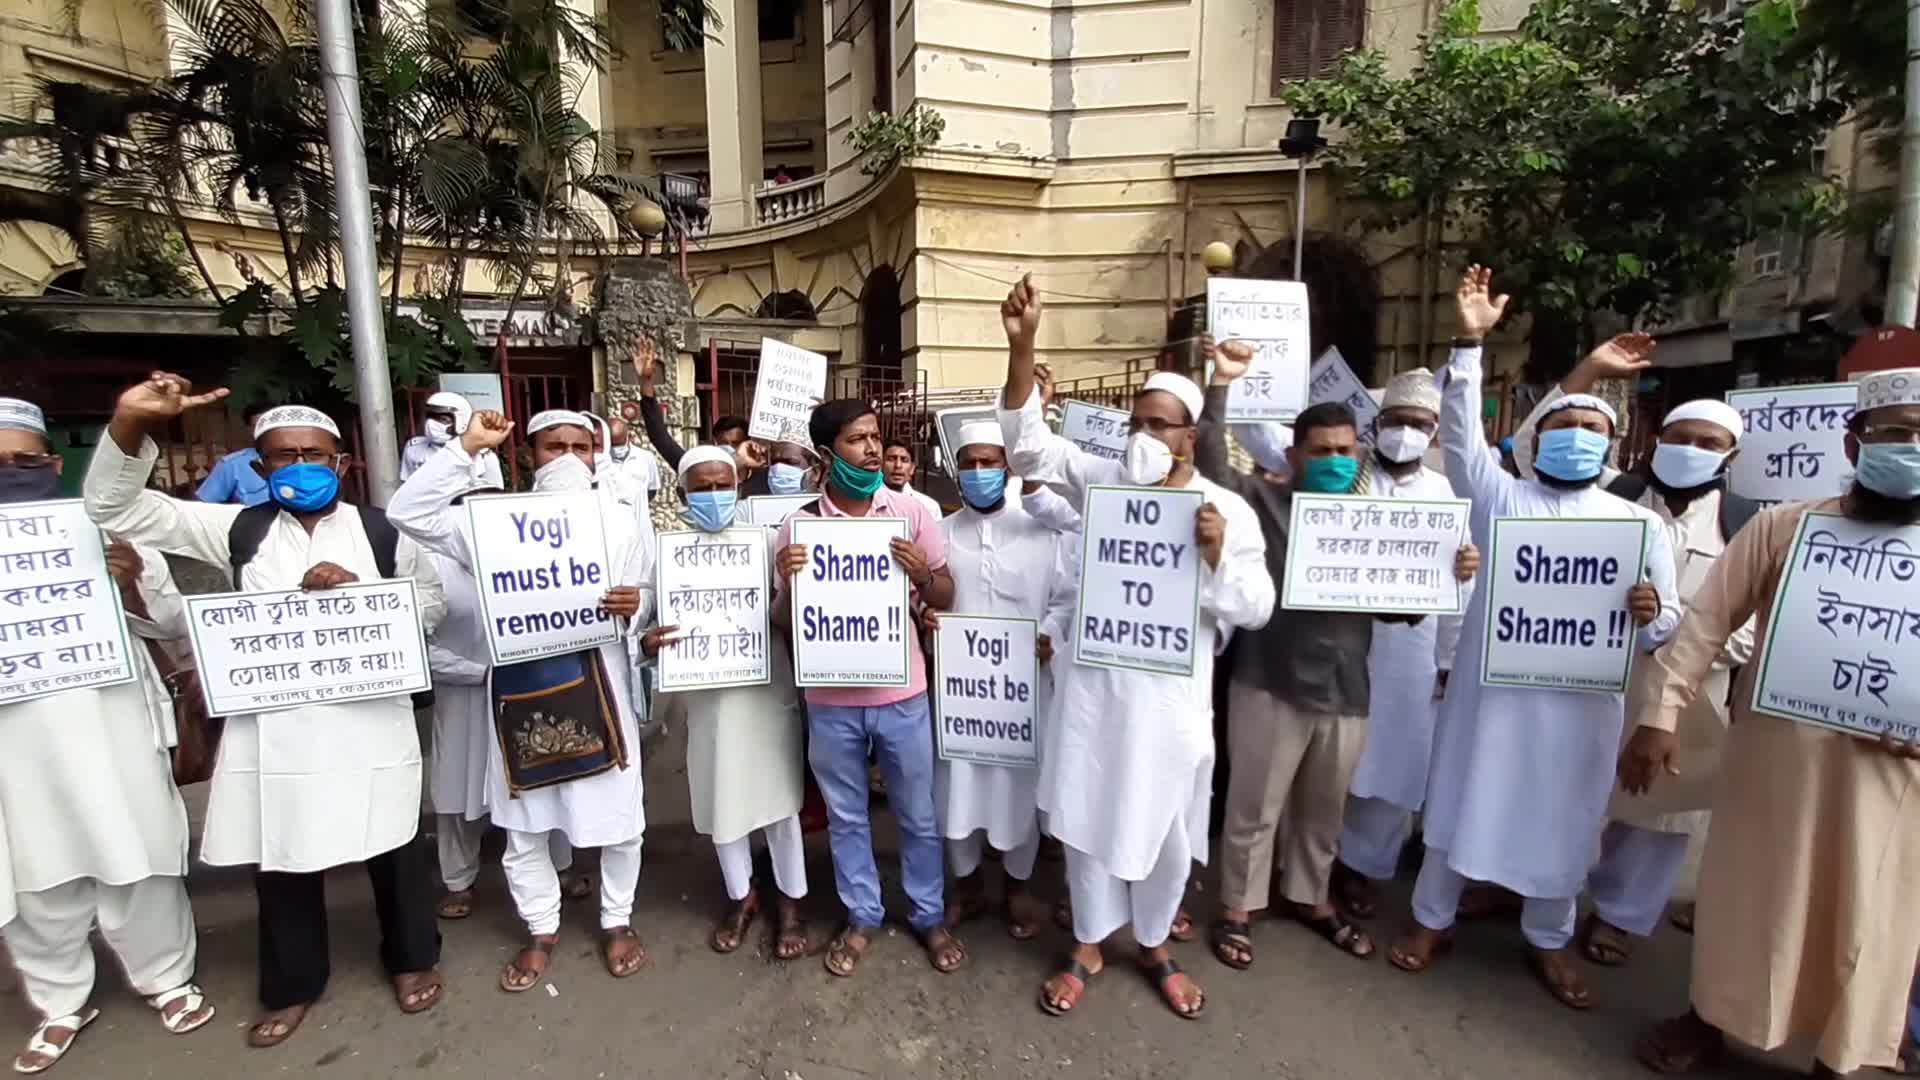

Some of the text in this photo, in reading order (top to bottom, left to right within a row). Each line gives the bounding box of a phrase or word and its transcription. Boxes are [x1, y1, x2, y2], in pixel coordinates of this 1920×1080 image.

[1243, 370, 1274, 401] চাই
[1764, 442, 1825, 479] প্রতি
[0, 513, 70, 539] ীষা,
[1125, 499, 1161, 525] NO
[510, 509, 571, 549] Yogi
[0, 548, 74, 573] ামার
[674, 536, 752, 567] ধর্ষকদের
[812, 544, 890, 581] Shame
[1098, 537, 1187, 569] MERCY
[1514, 544, 1619, 585] Shame
[1802, 530, 1920, 582] নির্যাতি
[491, 556, 601, 594] must be
[0, 579, 94, 606] কদের
[1121, 580, 1154, 607] TO
[201, 600, 257, 627] যোগী
[266, 594, 309, 625] তুমি
[316, 592, 356, 616] মঠে
[803, 605, 901, 642] Shame !!
[230, 622, 392, 654] সরকার চালানো
[1084, 615, 1189, 652] RAPISTS
[1496, 606, 1627, 649] Shame !!
[0, 640, 117, 677] ড়ব না!!
[500, 633, 615, 658] MINORITY YOUTH FEDERATION
[964, 629, 1010, 666] Yogi
[229, 662, 300, 687] তোমার
[309, 656, 352, 677] কাজ
[802, 672, 904, 681] MINORITY YOUTH FEDERATION
[1832, 652, 1897, 707] চাই
[946, 674, 1029, 702] must be
[944, 715, 1033, 742] removed
